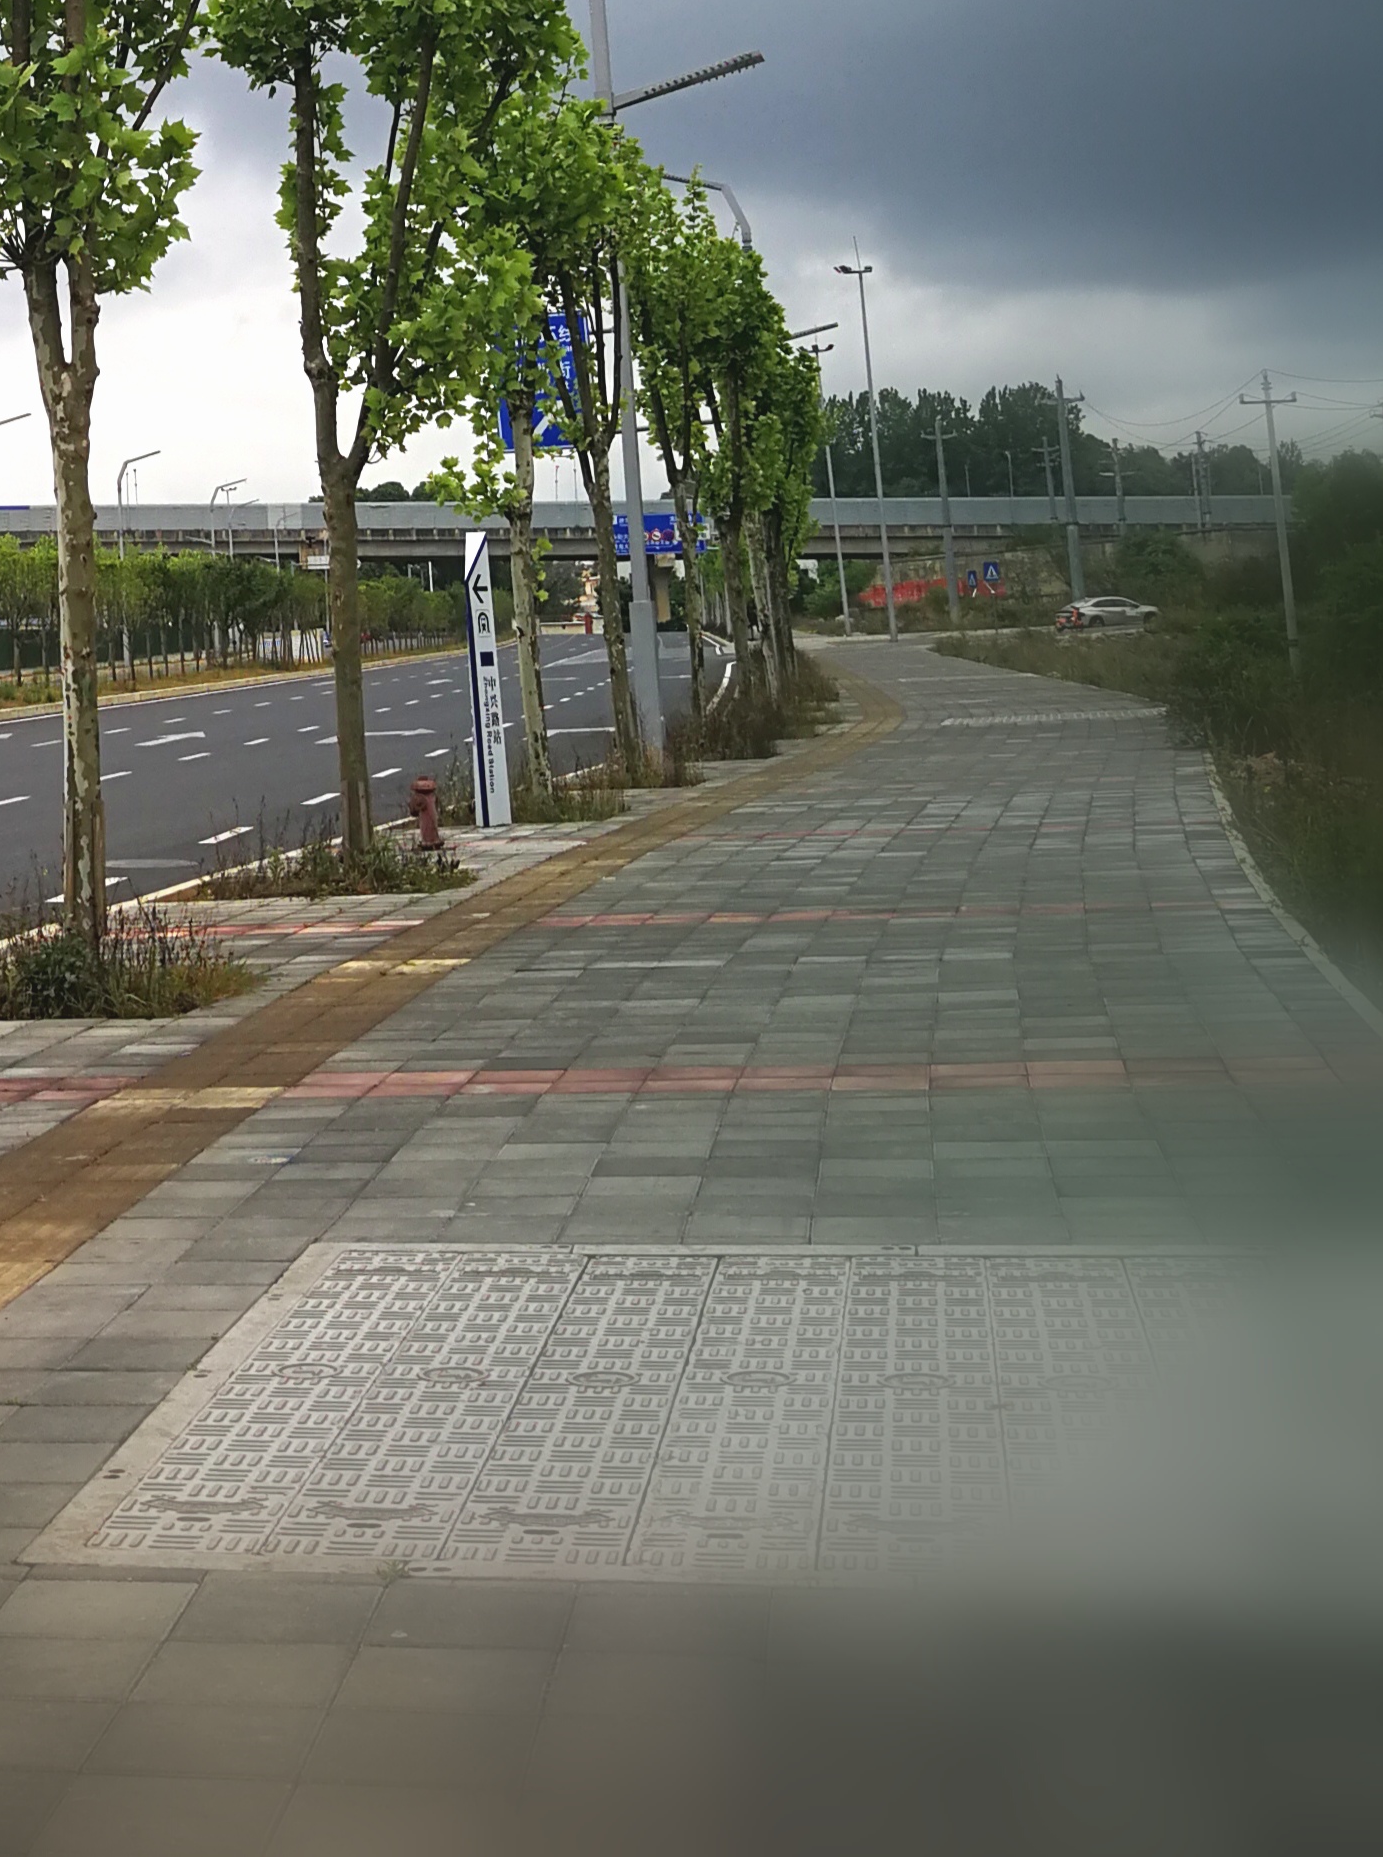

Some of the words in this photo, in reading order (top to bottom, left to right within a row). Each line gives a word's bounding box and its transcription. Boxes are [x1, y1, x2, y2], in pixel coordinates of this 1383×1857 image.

[488, 675, 502, 745] 中兴路站
[486, 730, 494, 757] Road
